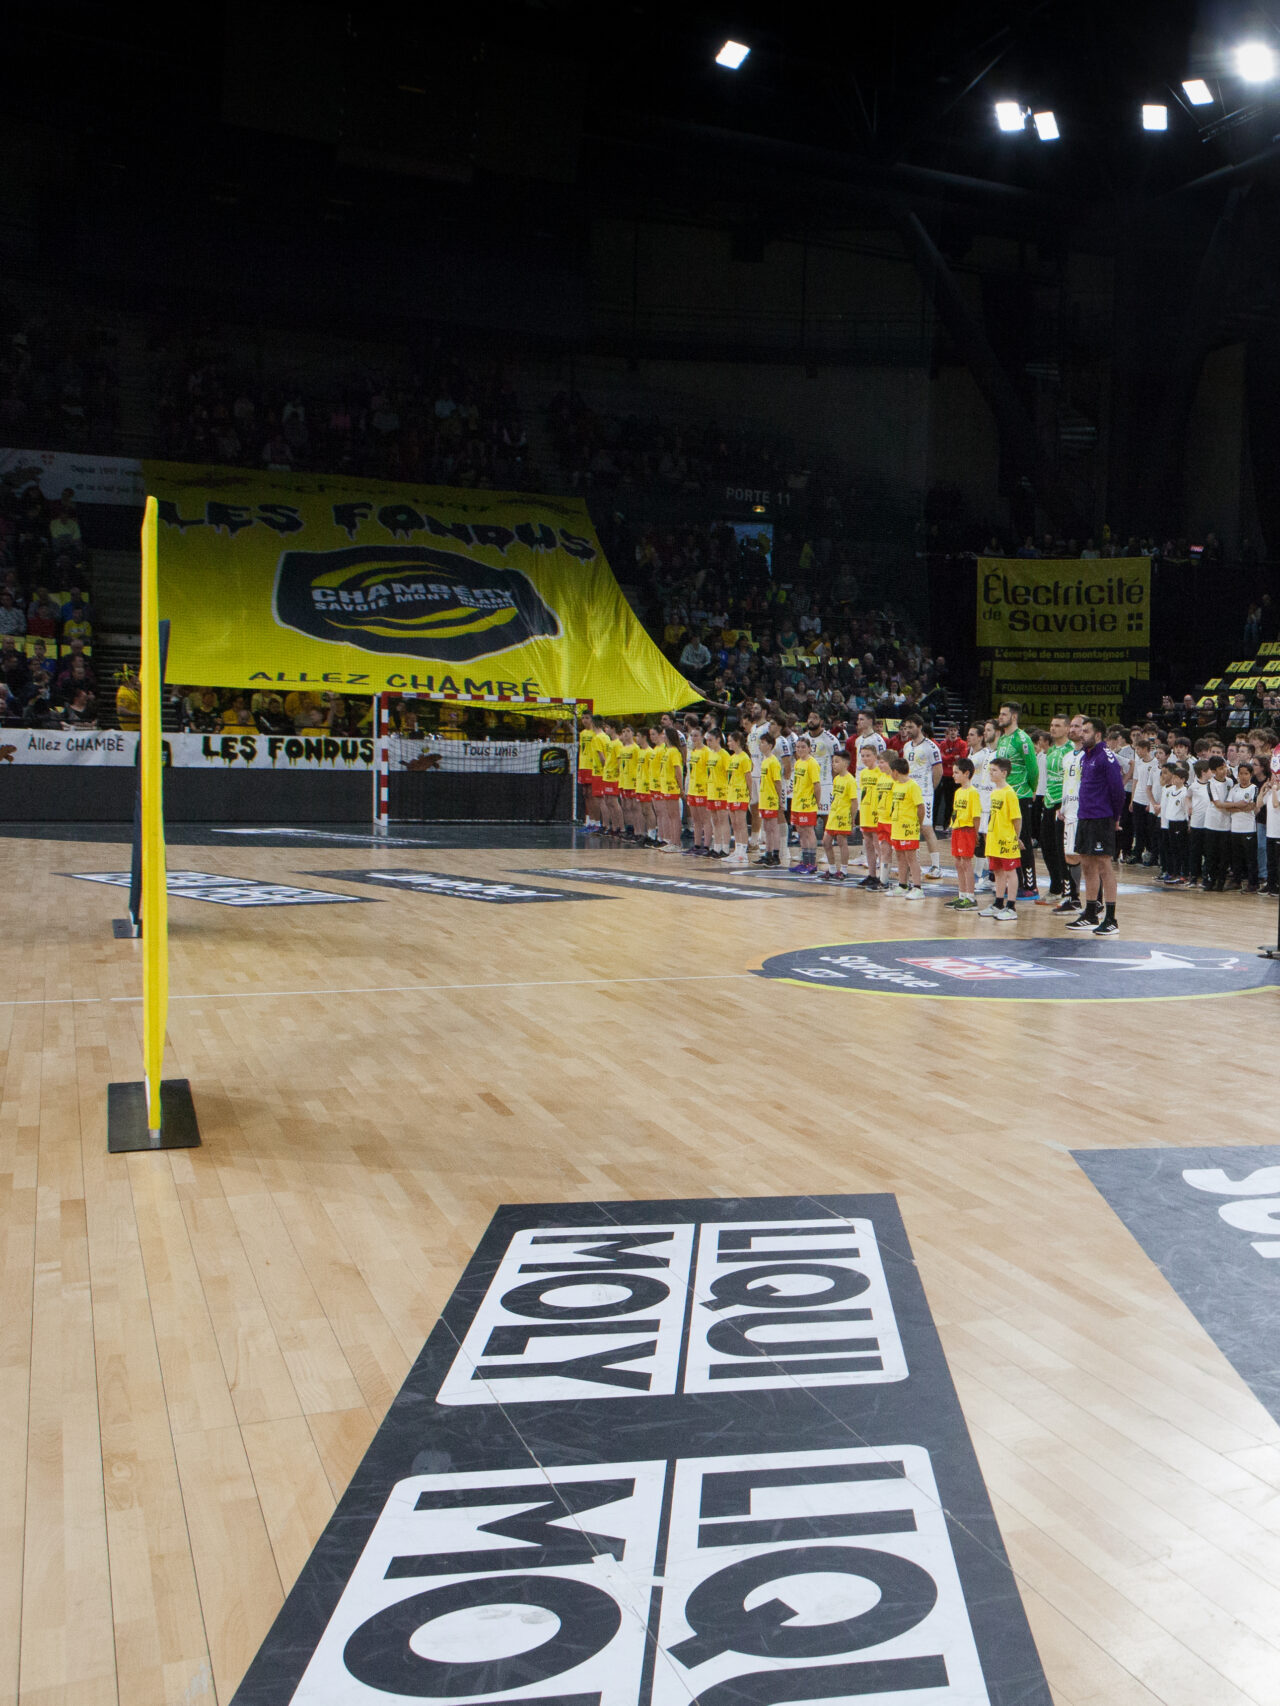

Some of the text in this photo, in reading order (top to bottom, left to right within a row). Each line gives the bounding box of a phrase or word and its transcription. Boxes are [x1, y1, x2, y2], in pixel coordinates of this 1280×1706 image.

[726, 487, 791, 506] PORTE 11
[158, 501, 598, 566] LES FONDUS
[311, 583, 514, 605] CHAMBÉRY
[982, 567, 1144, 606] Électricité
[314, 600, 390, 611] SAVOIE
[394, 592, 450, 603] MONT
[983, 608, 1117, 632] de Savoie
[248, 671, 541, 698] ALLEZ CHAMBÉ
[1054, 703, 1074, 717] ET
[28, 734, 62, 751] Allez
[202, 737, 375, 764] LES FONDUS
[462, 743, 519, 758] Tous unis
[1069, 764, 1077, 777] 6
[905, 957, 1018, 979] MOLY
[972, 955, 1076, 977] LIQUI
[470, 1231, 675, 1392] MOLY
[699, 1226, 884, 1381] LIQUI
